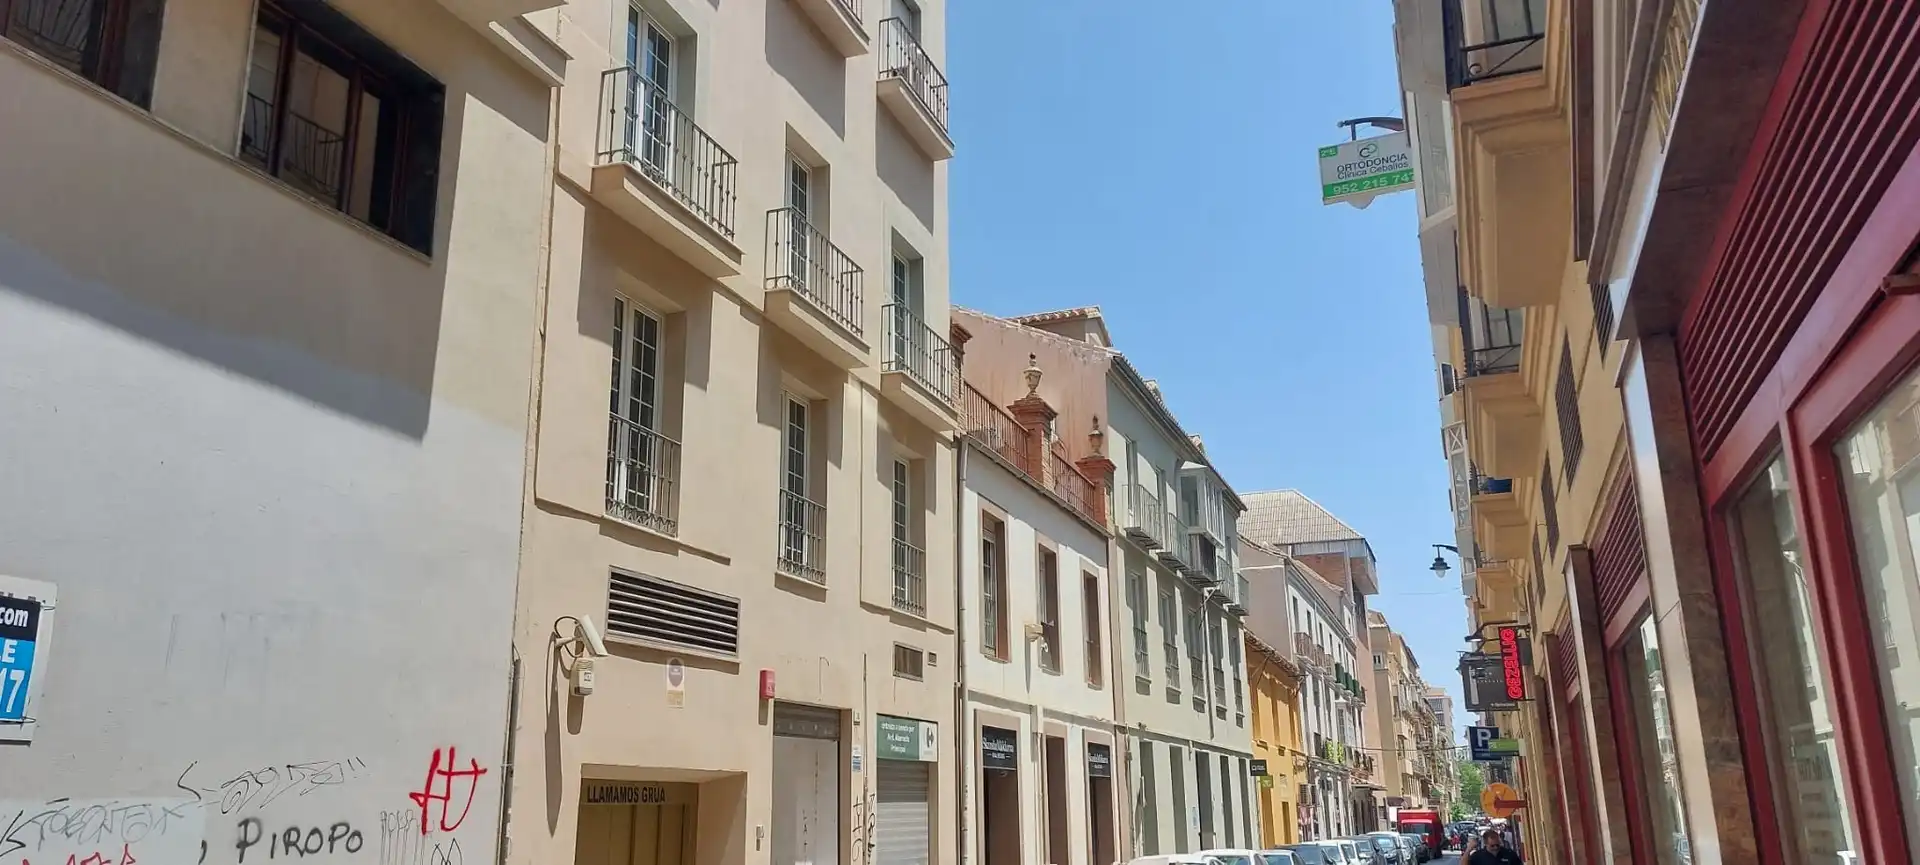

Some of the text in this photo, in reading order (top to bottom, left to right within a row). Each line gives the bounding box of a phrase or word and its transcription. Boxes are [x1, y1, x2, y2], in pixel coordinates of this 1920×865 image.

[1337, 153, 1408, 173] ORTODONCIA
[1370, 162, 1409, 174] Ceballos
[1333, 183, 1358, 195] 952
[1363, 176, 1388, 189] 215
[0, 639, 17, 663] E
[1500, 628, 1523, 699] GEZELLIG
[1477, 728, 1491, 747] P
[587, 784, 666, 803] LLAMAMOS GRUA
[236, 816, 363, 864] PIROPO
